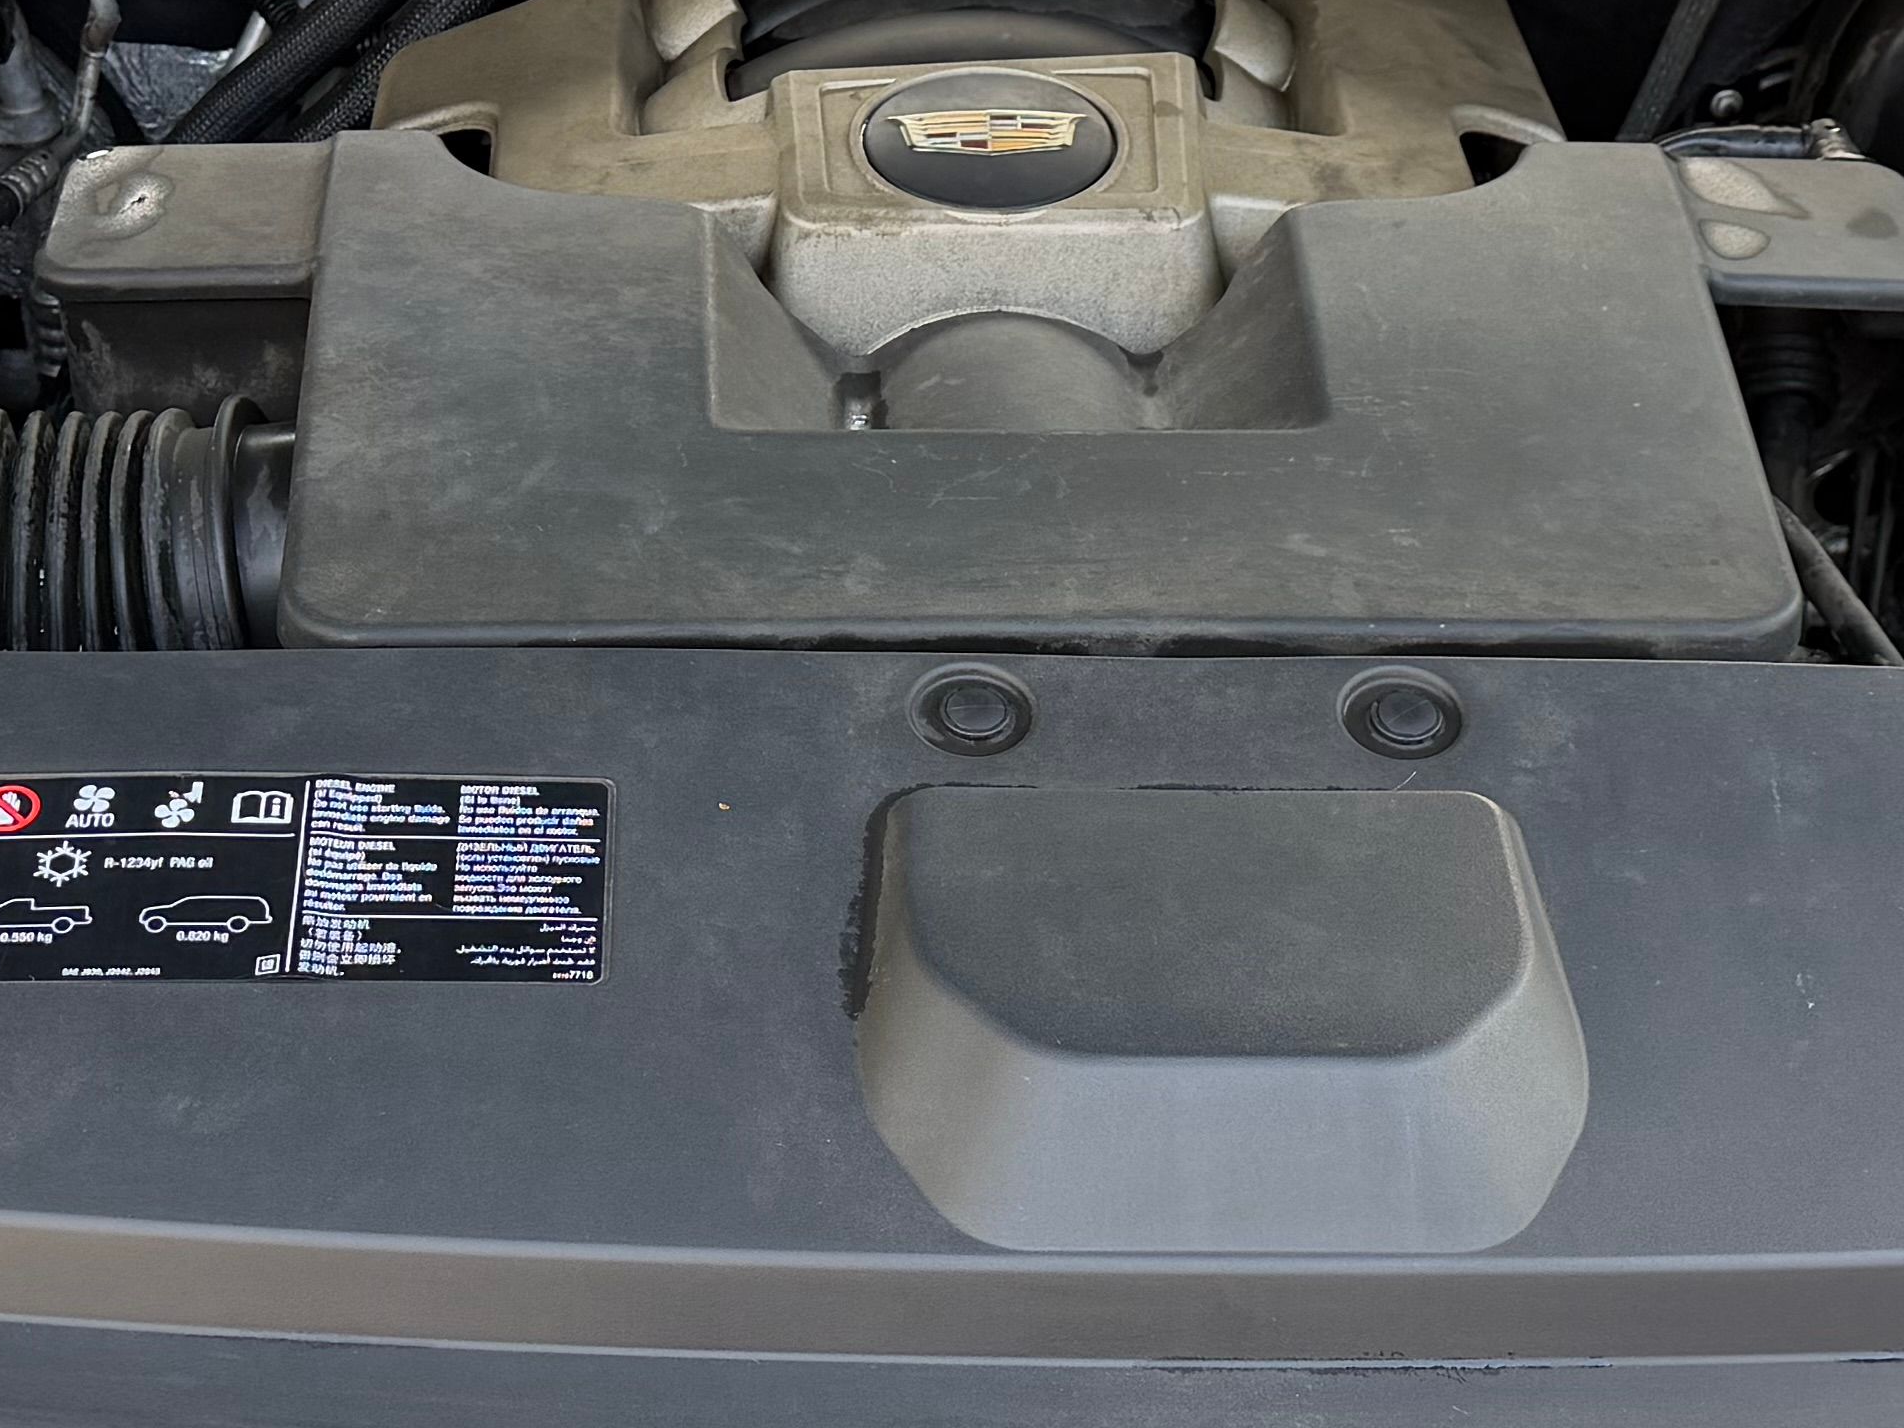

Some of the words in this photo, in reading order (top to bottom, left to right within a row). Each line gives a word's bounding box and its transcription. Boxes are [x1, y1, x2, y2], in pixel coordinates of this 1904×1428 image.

[315, 779, 352, 791] DIESEL
[355, 783, 396, 793] ENGINE
[460, 785, 499, 794] MOTOR
[502, 786, 540, 796] DIESEL
[313, 799, 327, 808] Do
[330, 802, 347, 810] not
[350, 804, 368, 812] use
[371, 805, 411, 815] starting
[535, 807, 549, 815] de
[65, 813, 115, 828] AUTO
[311, 820, 330, 828] can
[370, 815, 405, 824] engine
[408, 816, 451, 824] damage
[310, 837, 355, 850] MOTEUR
[358, 841, 396, 851] DIESEL
[104, 857, 163, 870] R-1234yf
[169, 857, 196, 868] PAG
[198, 857, 214, 868] oil
[419, 893, 432, 902] en
[37, 932, 53, 944] kg
[213, 931, 229, 943] kg
